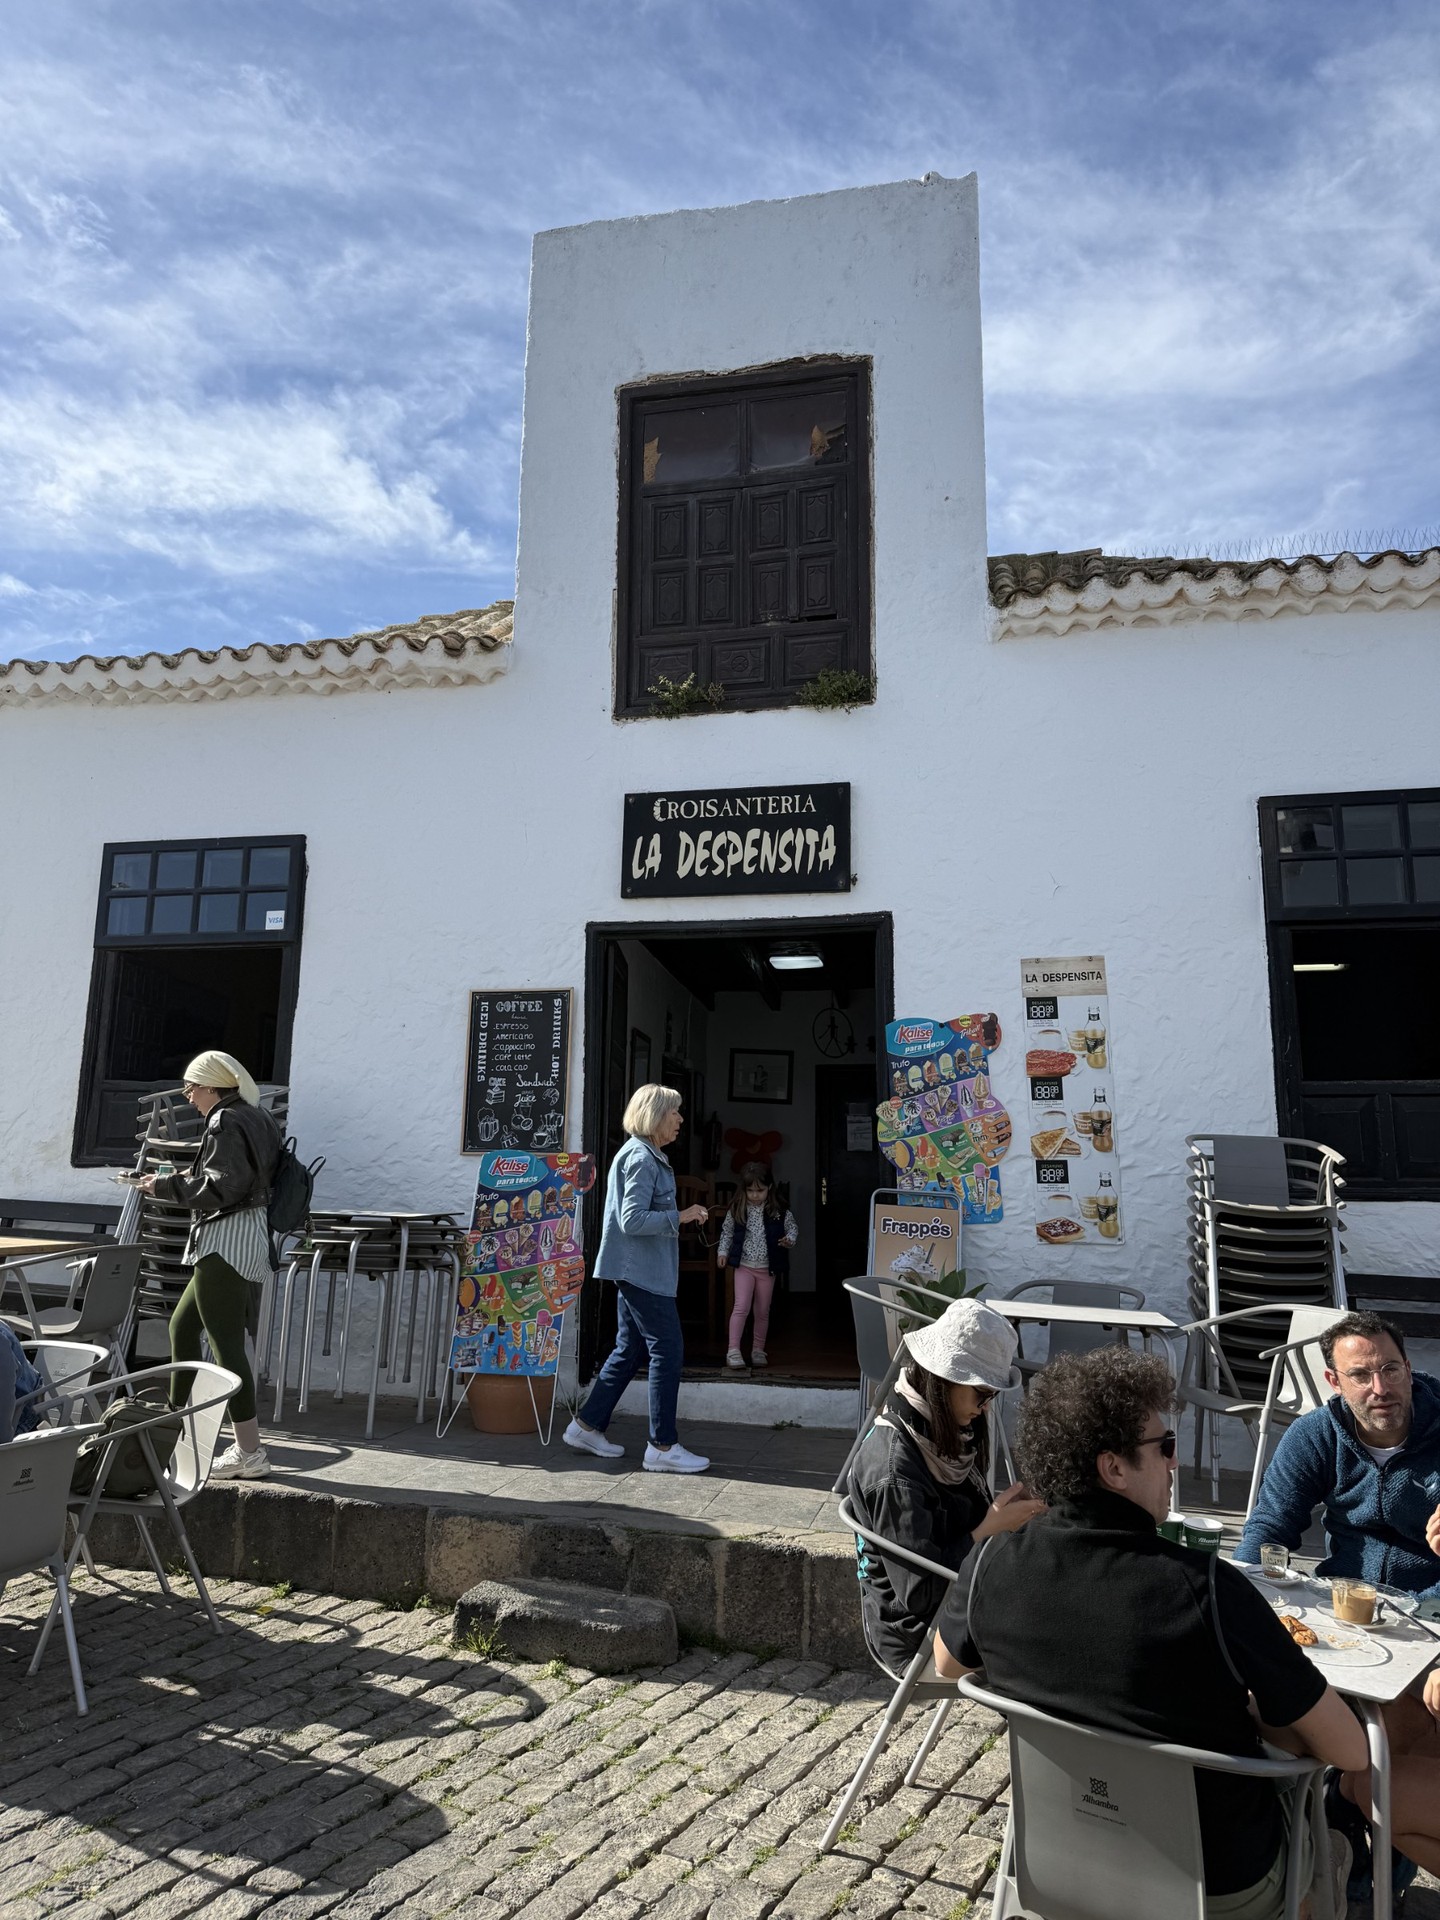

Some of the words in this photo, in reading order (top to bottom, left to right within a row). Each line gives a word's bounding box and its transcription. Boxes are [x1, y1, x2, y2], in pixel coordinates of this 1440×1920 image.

[653, 794, 817, 822] CROISANTERIA
[632, 832, 662, 880] LA
[676, 824, 837, 880] DESPENSITA
[268, 916, 283, 924] VISA
[1025, 974, 1038, 983] LA
[1042, 971, 1103, 982] DESPENSITA
[480, 1001, 489, 1029] ICED
[495, 1001, 543, 1012] COFFEE
[552, 998, 562, 1048] DRINKS
[899, 1023, 933, 1044] Kalise
[905, 1045, 922, 1053] para
[923, 1040, 945, 1050] todos
[477, 1032, 488, 1082] DRINKS
[891, 1059, 910, 1070] Trufo
[551, 1054, 560, 1079] HOT
[514, 1094, 537, 1107] Juice
[503, 1136, 519, 1148] TEA
[492, 1156, 529, 1176] Kalise
[496, 1178, 514, 1187] para
[516, 1176, 538, 1184] todos
[480, 1192, 500, 1201] Trufo
[881, 1217, 953, 1239] Frappés
[1081, 1794, 1119, 1812] Alhambra
